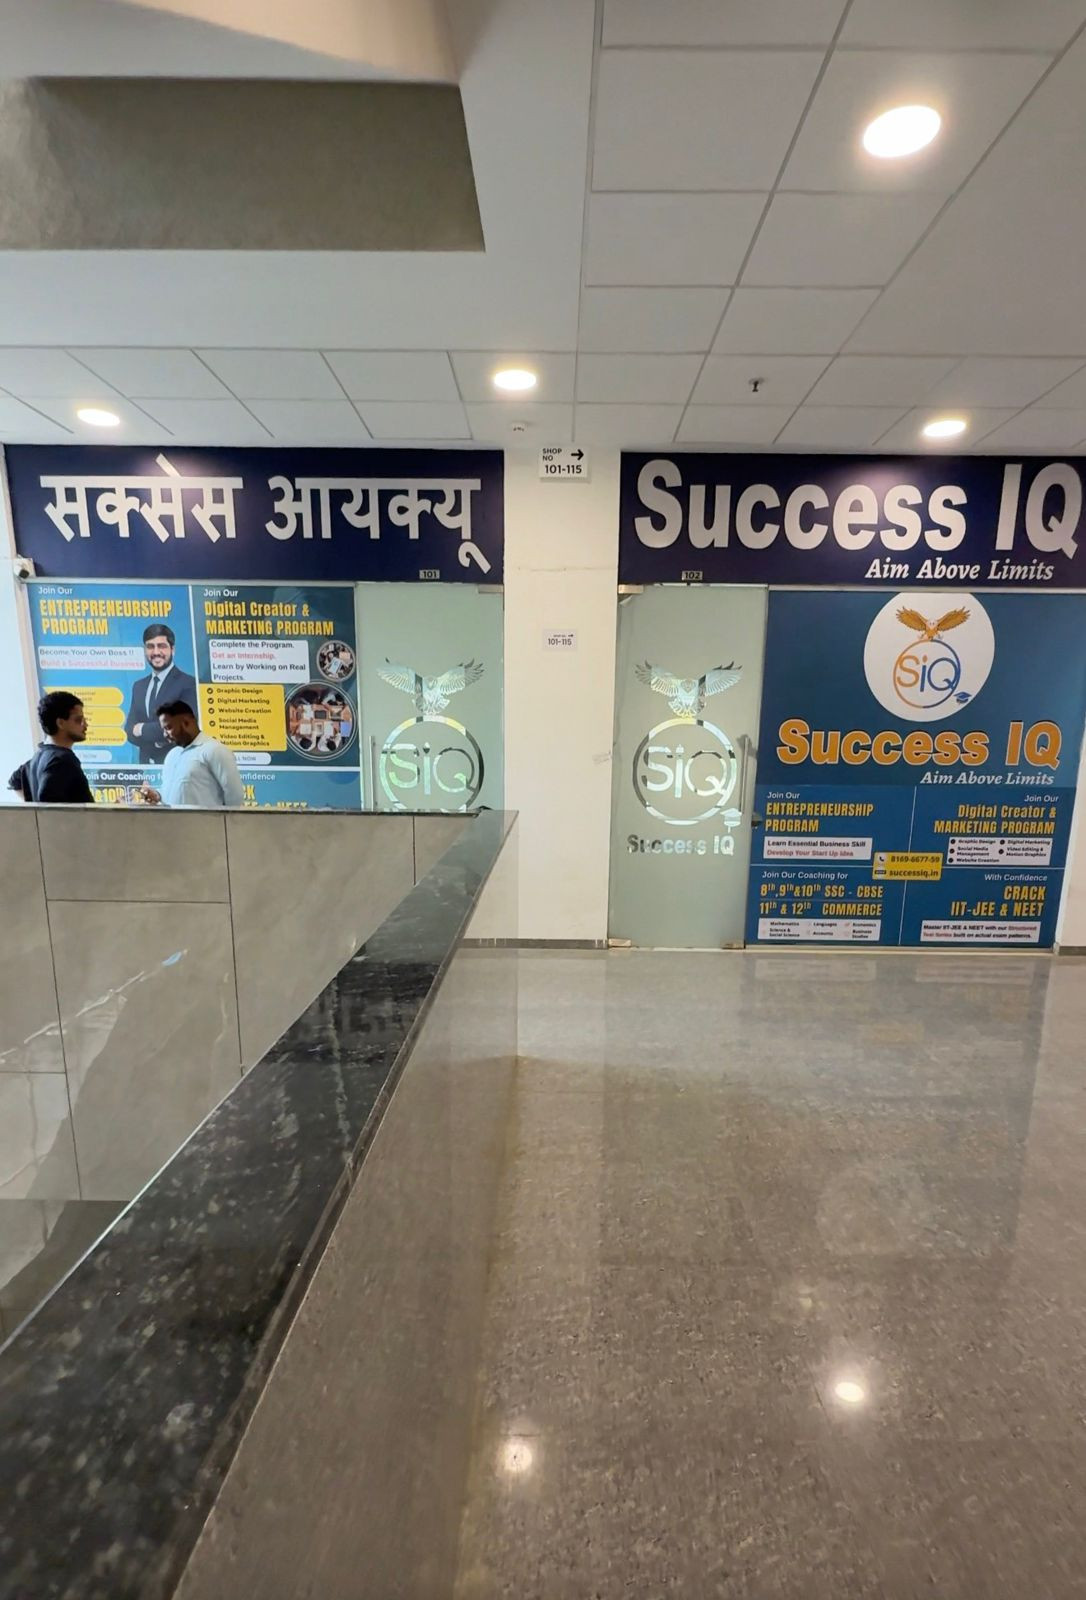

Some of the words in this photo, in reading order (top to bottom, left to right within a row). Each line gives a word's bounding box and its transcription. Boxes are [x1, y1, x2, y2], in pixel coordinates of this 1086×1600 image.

[545, 465, 582, 474] 101-115
[40, 453, 243, 543] सक्सेस
[265, 475, 492, 574] आयक्यू
[634, 459, 968, 551] Success
[995, 462, 1084, 560] IQ
[422, 570, 437, 578] 101
[685, 571, 701, 579] 102
[865, 558, 909, 579] Aim
[916, 557, 981, 579] Above
[987, 560, 1055, 580] Limits
[38, 586, 55, 595] Join
[58, 586, 73, 595] Our
[203, 589, 221, 597] Join
[223, 589, 238, 597] Our
[39, 599, 172, 618] ENTREPRENEURSHIP
[204, 601, 246, 617] Digital
[250, 602, 296, 617] Creator
[302, 604, 309, 616] &
[41, 618, 109, 636] PROGRAM
[206, 620, 272, 635] MARKETING
[277, 620, 334, 636] PROGRAM
[211, 641, 246, 649] Complete
[261, 641, 294, 650] Program.
[235, 663, 244, 672] by
[246, 664, 276, 672] Working
[776, 718, 989, 766] Success
[1005, 720, 1063, 770] IQ
[118, 772, 155, 782] Coaching
[920, 771, 954, 784] Aim
[955, 771, 1003, 784] Above
[1005, 772, 1055, 785] Limits
[766, 802, 874, 817] ENTREPRENEURSHIP
[958, 805, 997, 818] Digital
[1001, 805, 1046, 818] Creator
[1050, 807, 1057, 818] &
[765, 819, 819, 832] PROGRAM
[934, 820, 997, 833] MARKETING
[1001, 821, 1055, 834] PROGRAM
[627, 834, 706, 855] Success
[713, 835, 734, 856] IQ
[798, 871, 835, 880] Coaching
[889, 869, 938, 877] successiq.in
[1004, 874, 1048, 882] Confidence
[824, 886, 845, 897] SSC
[857, 886, 883, 898] CBSE
[1004, 886, 1047, 900] CRACK
[760, 902, 777, 914] 11th
[780, 904, 787, 914] &
[792, 902, 812, 915] 12th
[822, 903, 882, 915] COMMERCE
[951, 902, 996, 916] IIT-JEE
[1000, 904, 1008, 916] &
[1013, 902, 1044, 916] NEET
